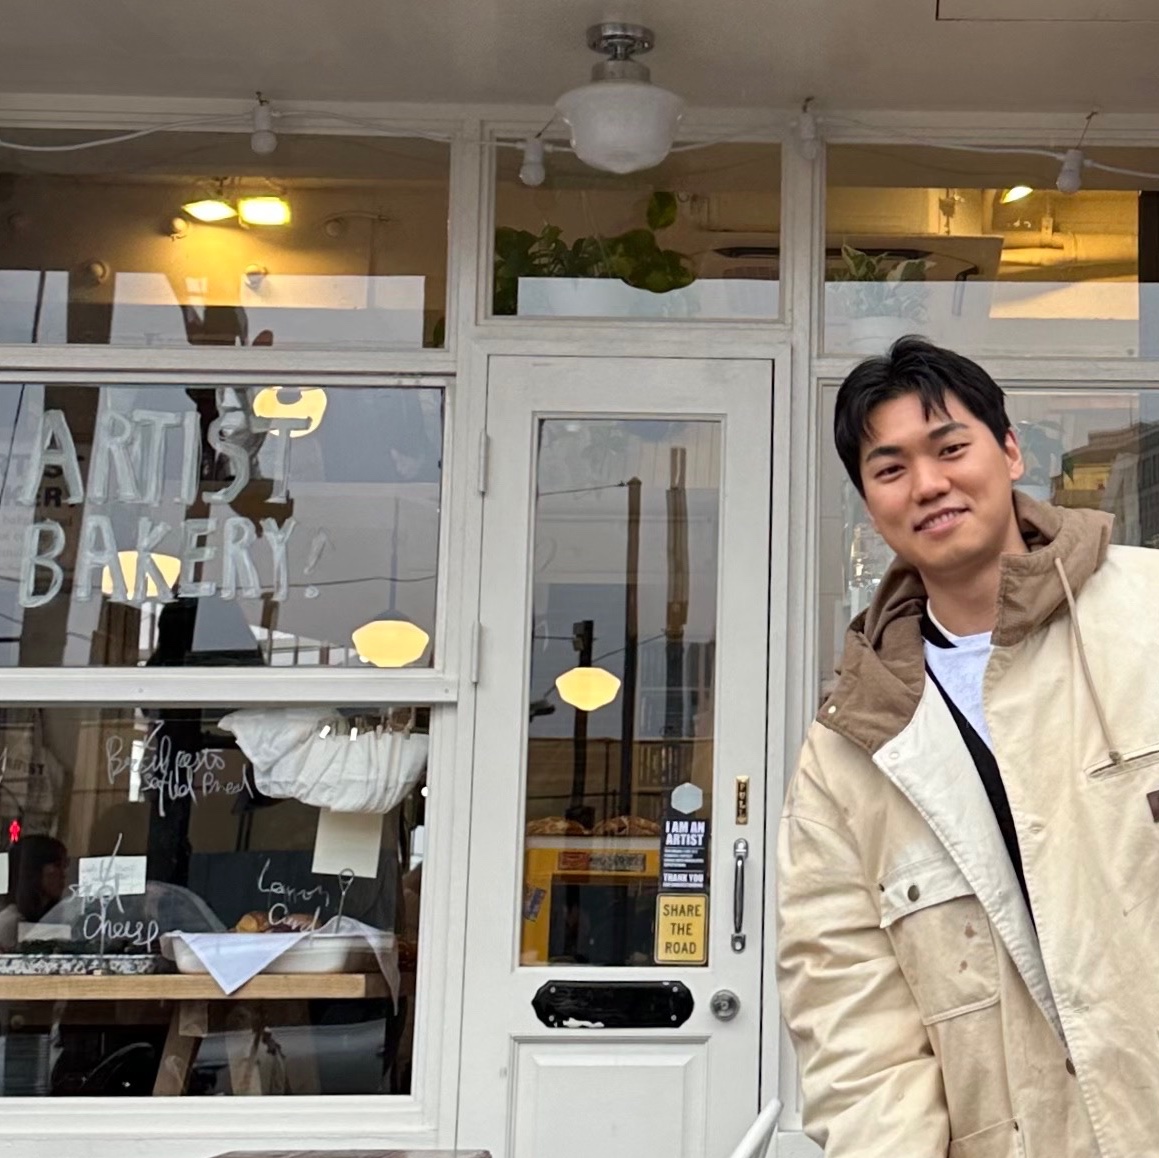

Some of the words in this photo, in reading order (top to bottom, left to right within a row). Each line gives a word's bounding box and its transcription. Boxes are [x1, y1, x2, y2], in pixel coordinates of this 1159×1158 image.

[18, 409, 313, 505] ARTIST
[665, 821, 670, 833] I
[671, 821, 688, 833] AM
[690, 821, 705, 834] AN
[665, 833, 704, 846] ARTIST
[663, 872, 687, 883] THANK
[689, 872, 704, 883] YOU
[663, 904, 702, 917] SHARE
[670, 923, 693, 936] THE
[664, 942, 697, 954] ROAD
